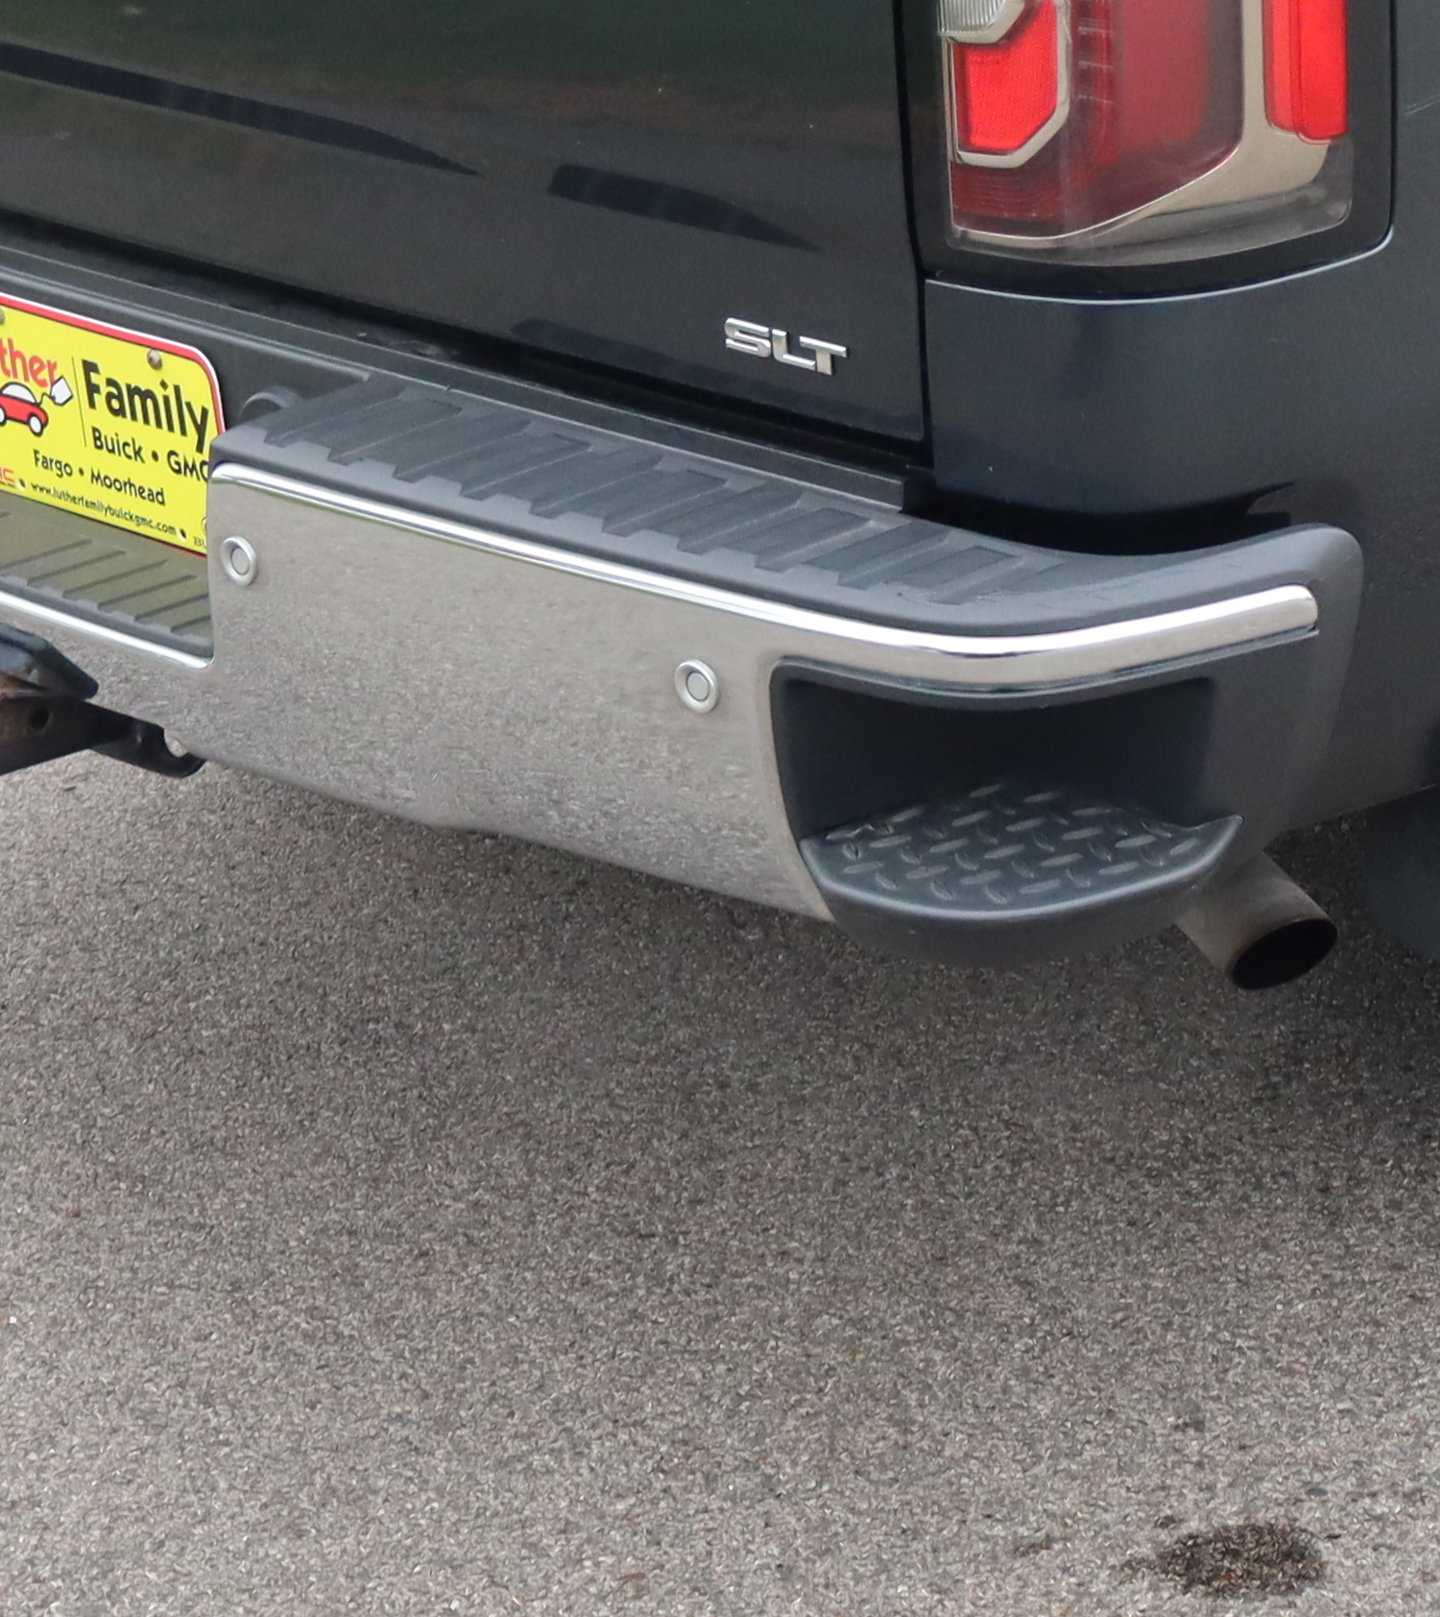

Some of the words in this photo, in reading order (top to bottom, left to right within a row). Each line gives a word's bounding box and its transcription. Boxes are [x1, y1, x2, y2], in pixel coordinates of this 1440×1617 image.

[724, 317, 848, 376] SLT
[81, 358, 209, 455] Family
[91, 425, 146, 464] Buick
[33, 449, 73, 480] Fargo
[90, 467, 167, 507] Moorhead
